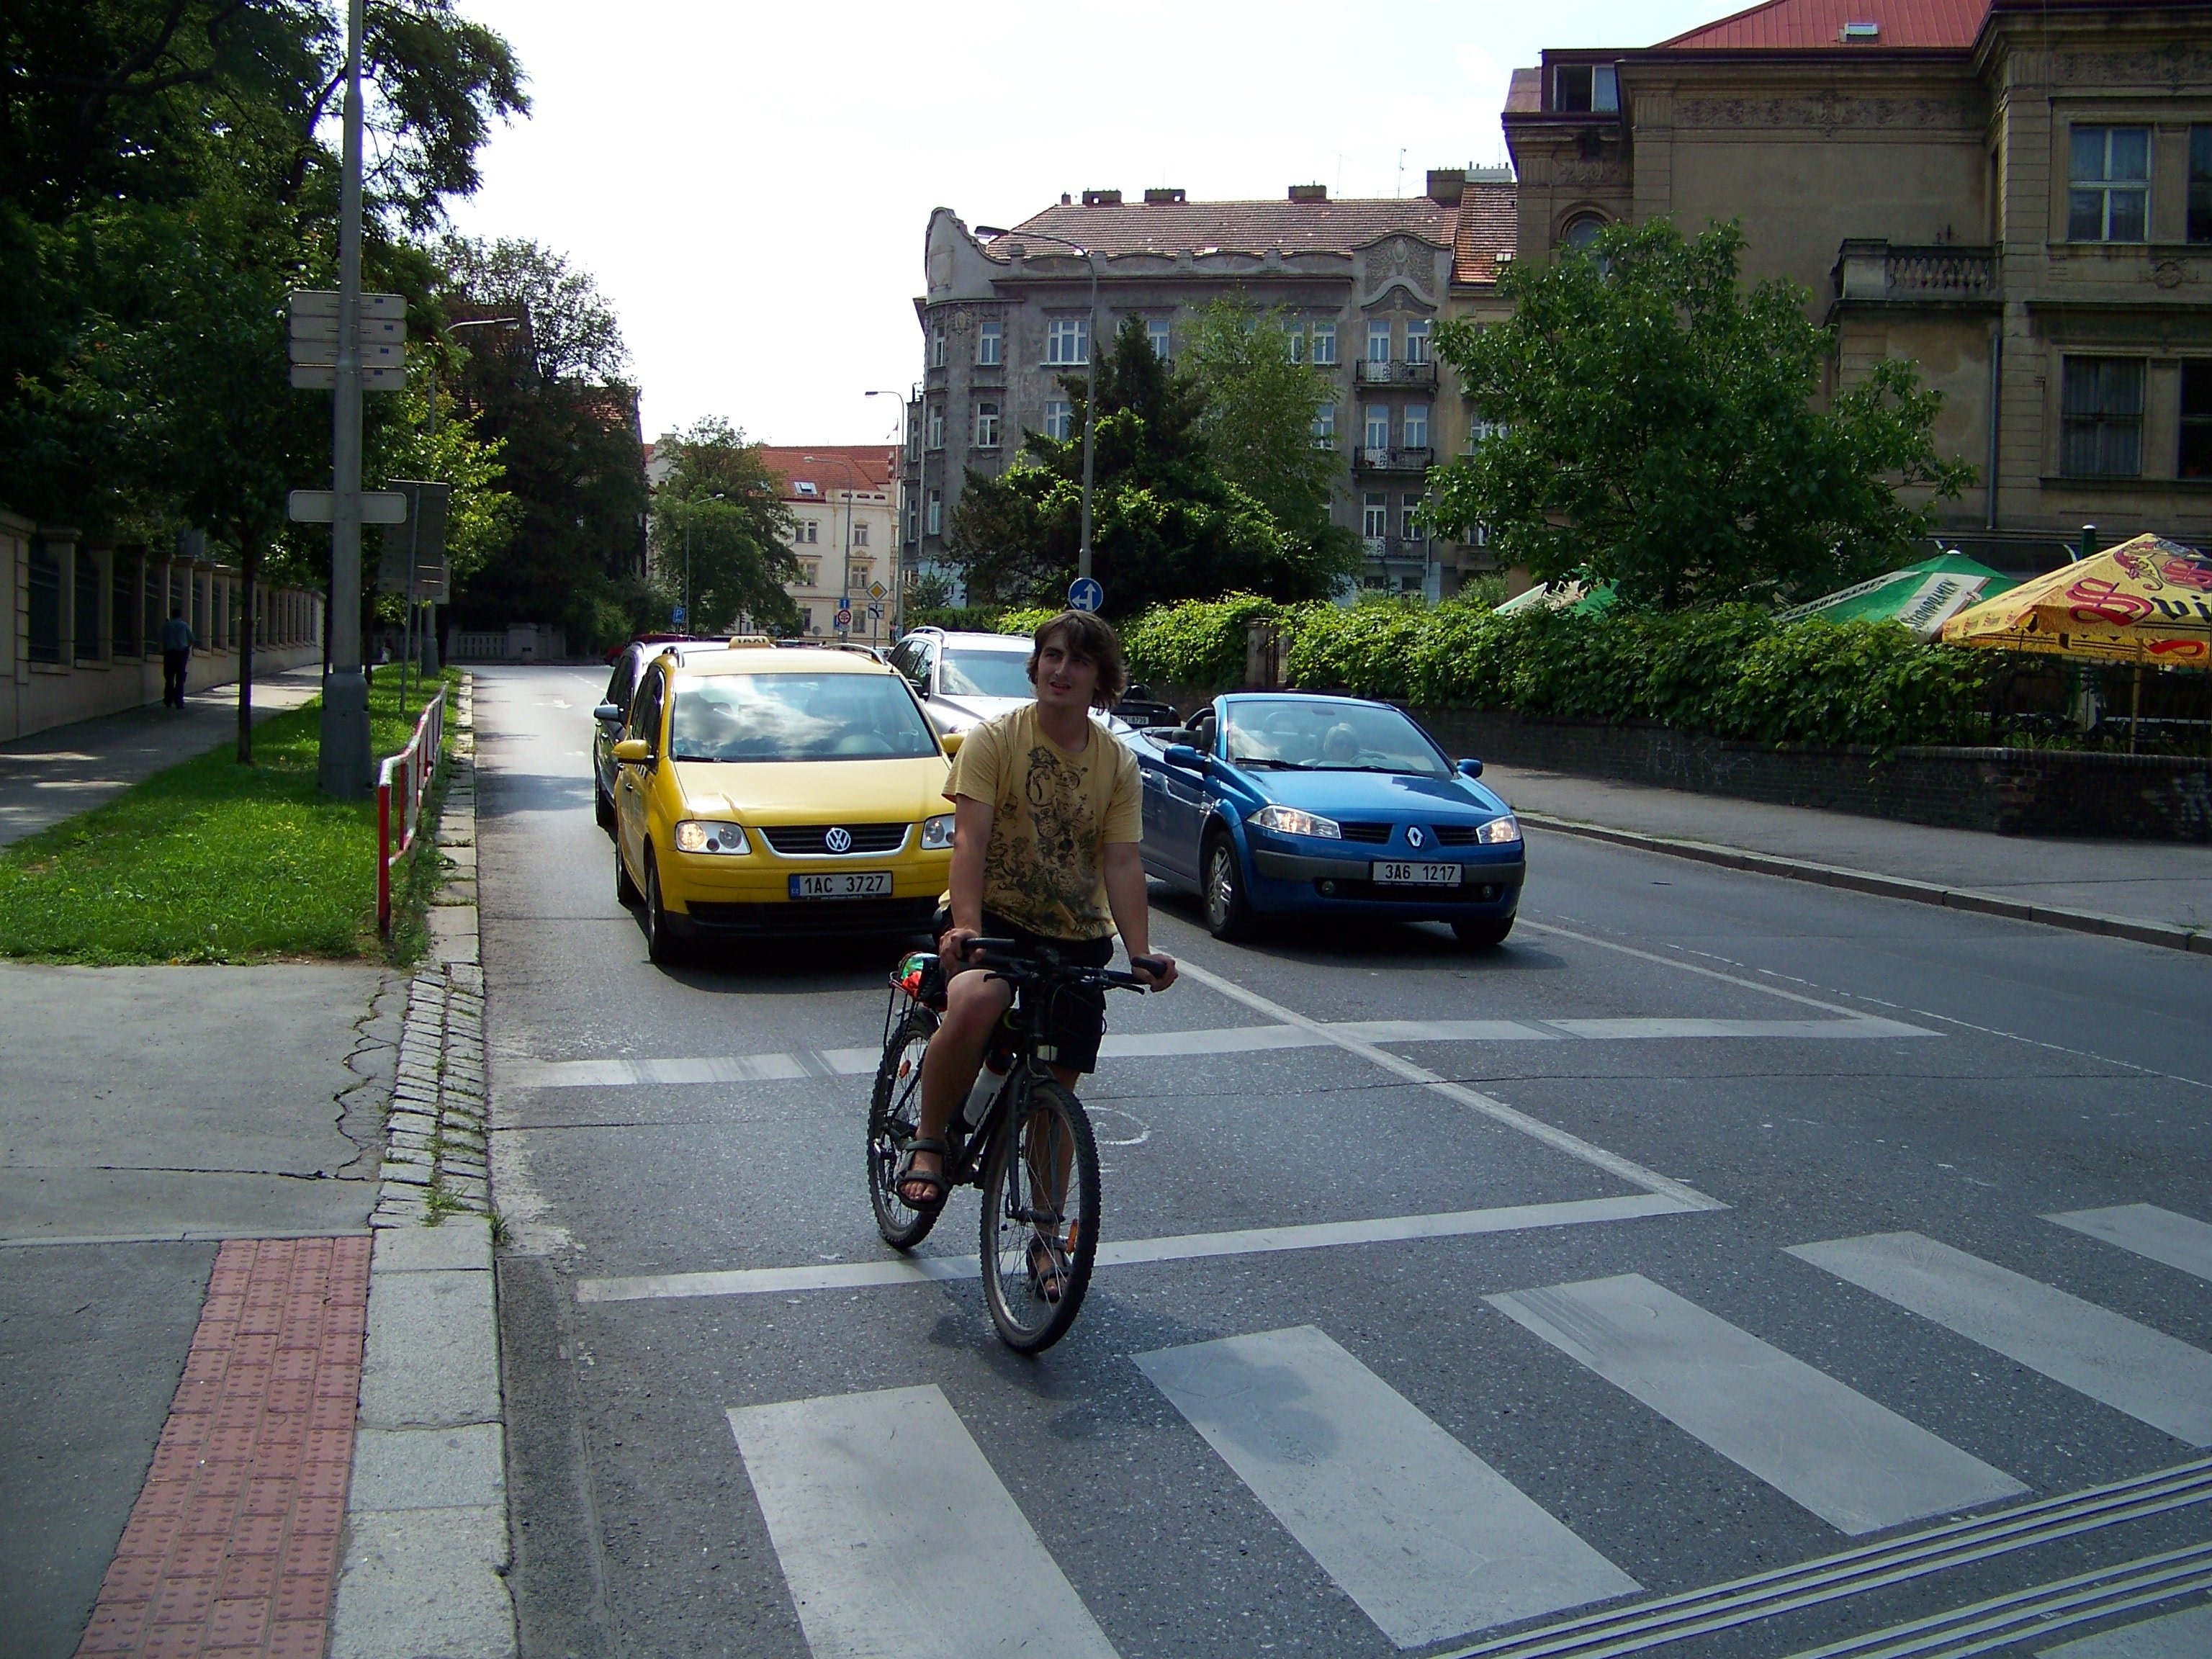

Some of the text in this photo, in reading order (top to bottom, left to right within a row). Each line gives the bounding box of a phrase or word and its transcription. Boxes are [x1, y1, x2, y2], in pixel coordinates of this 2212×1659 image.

[1899, 578, 1961, 629] STAROPRAMEN
[675, 609, 683, 618] P
[1385, 864, 1455, 881] 3A6 1217
[805, 876, 884, 894] 1AC 3727
